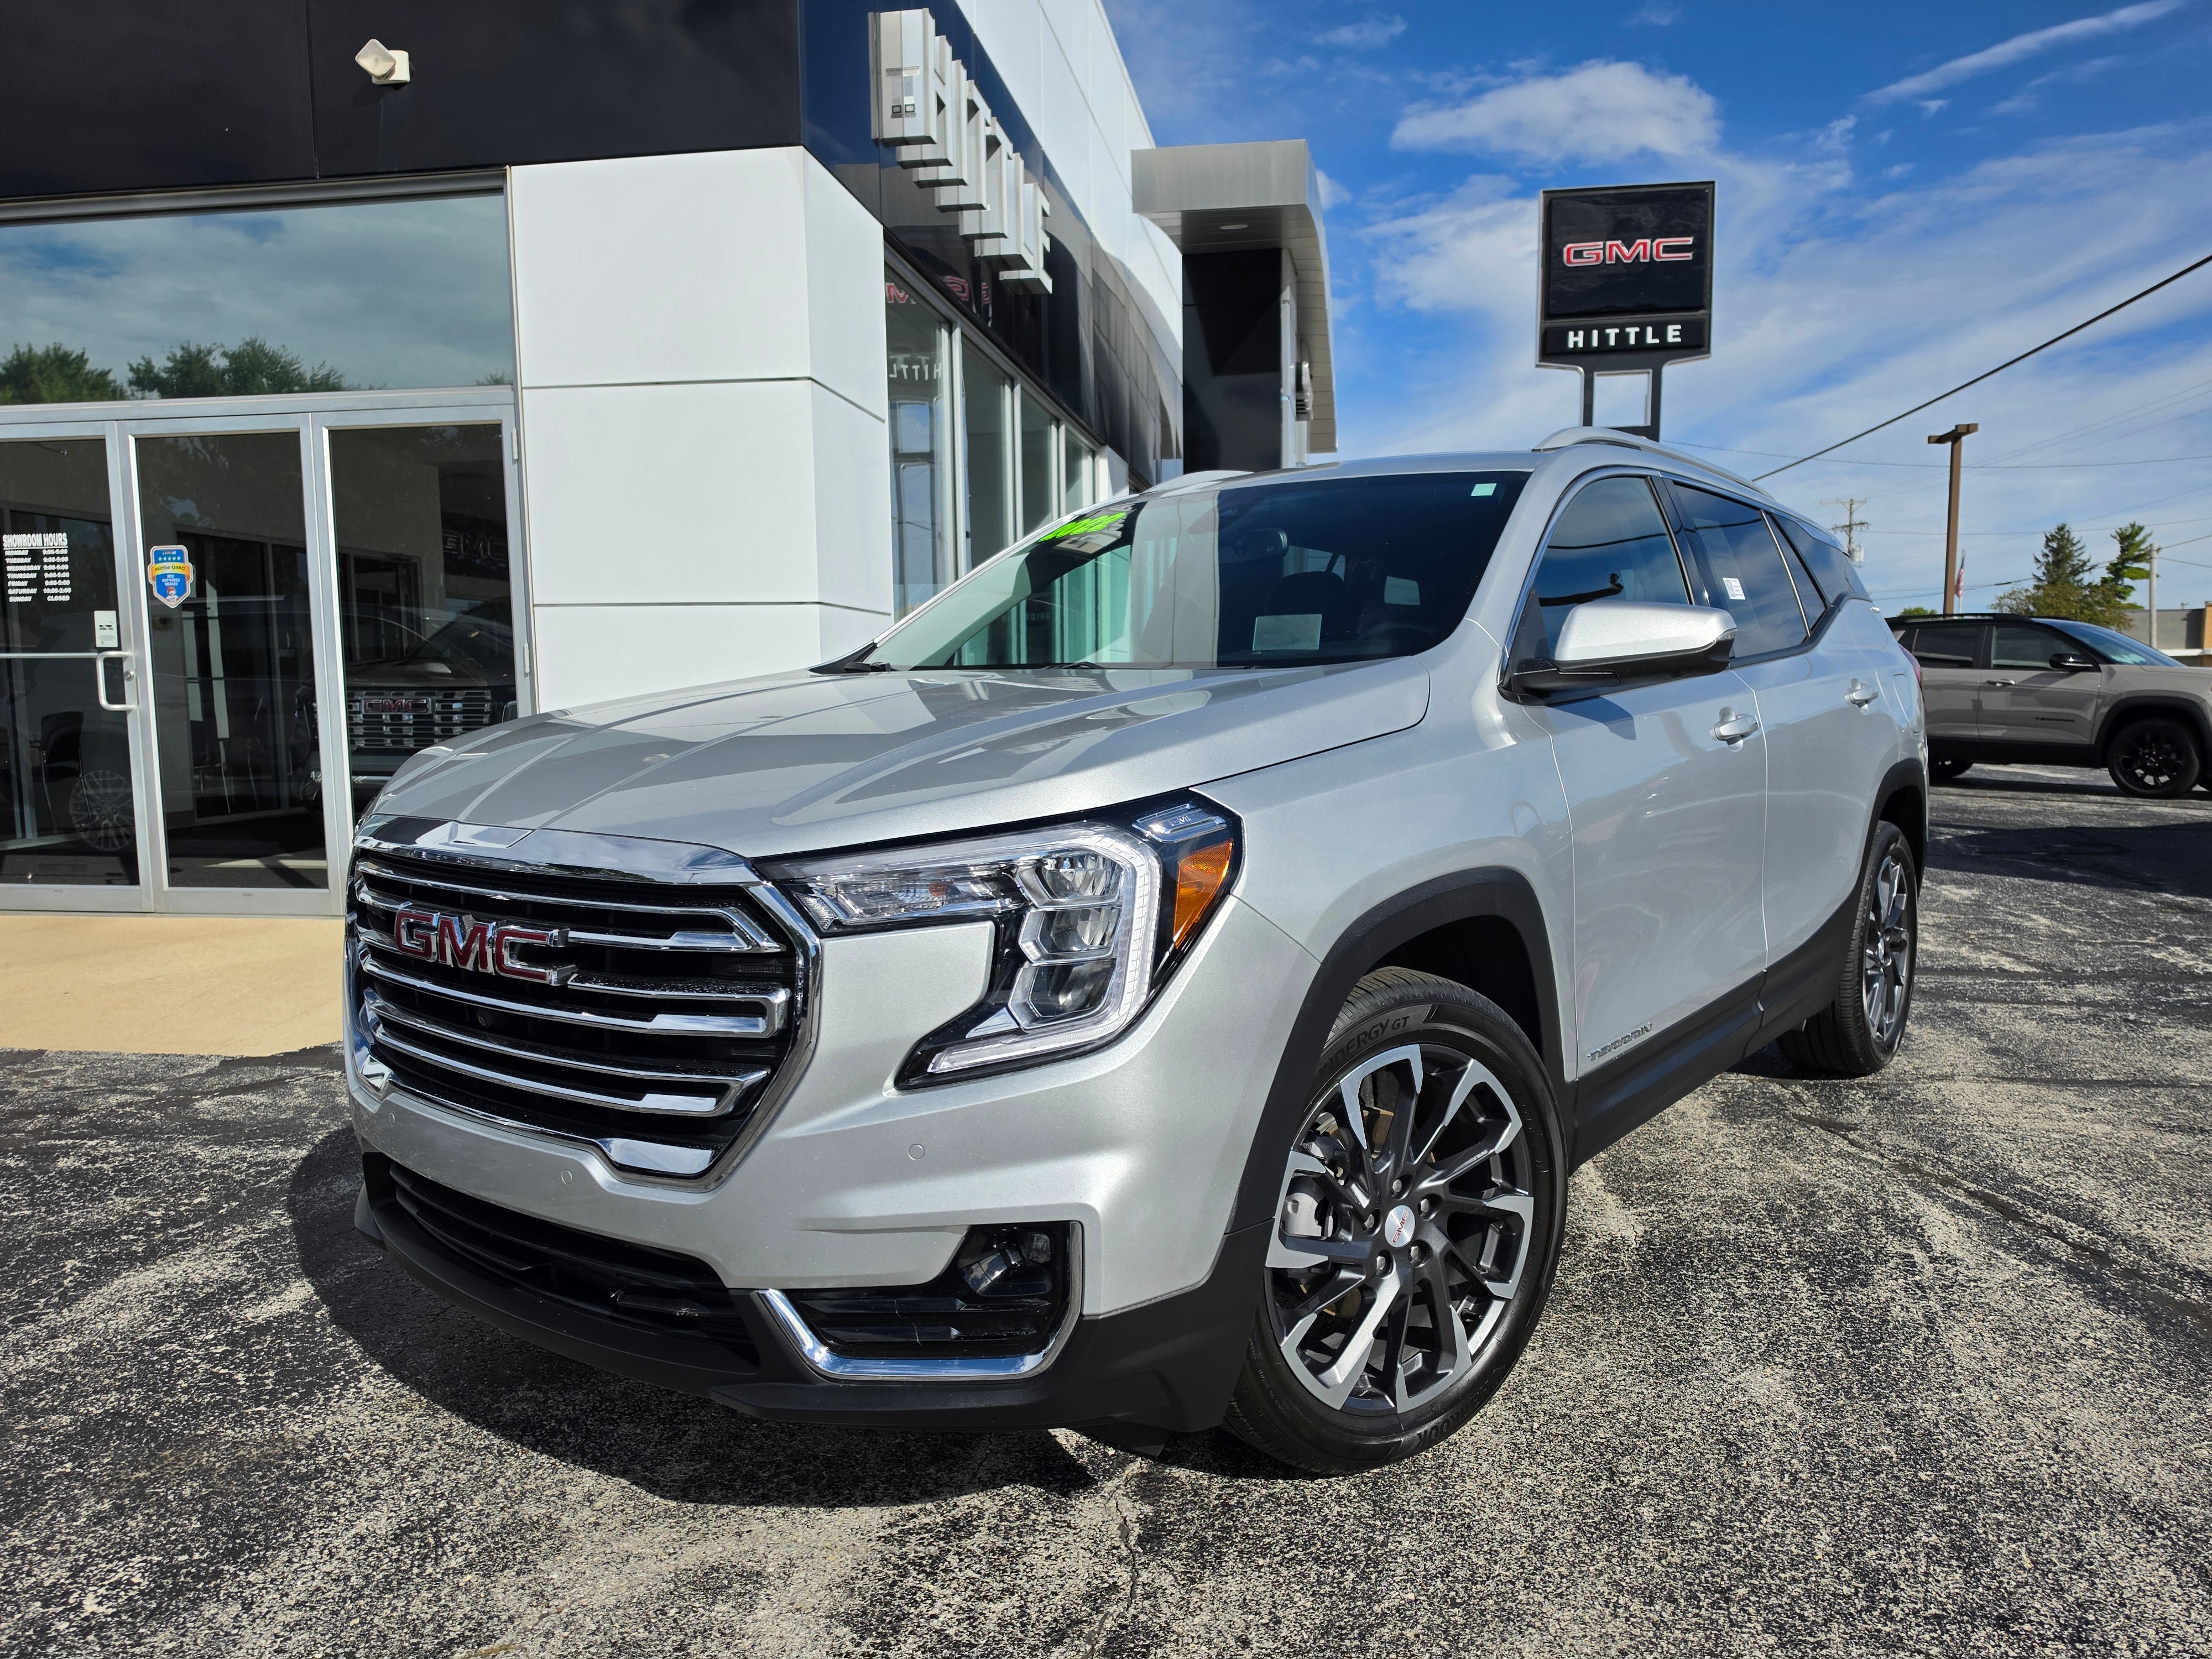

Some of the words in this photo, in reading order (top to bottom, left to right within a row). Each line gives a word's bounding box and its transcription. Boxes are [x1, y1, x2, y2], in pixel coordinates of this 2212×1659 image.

[1563, 236, 1694, 267] GMC
[1568, 325, 1682, 348] HITTLE
[3, 533, 43, 547] SHOWROOM
[43, 533, 67, 546] HOURS
[364, 698, 427, 713] GMC
[395, 908, 572, 987] GMC
[1391, 1016, 1410, 1031] GT
